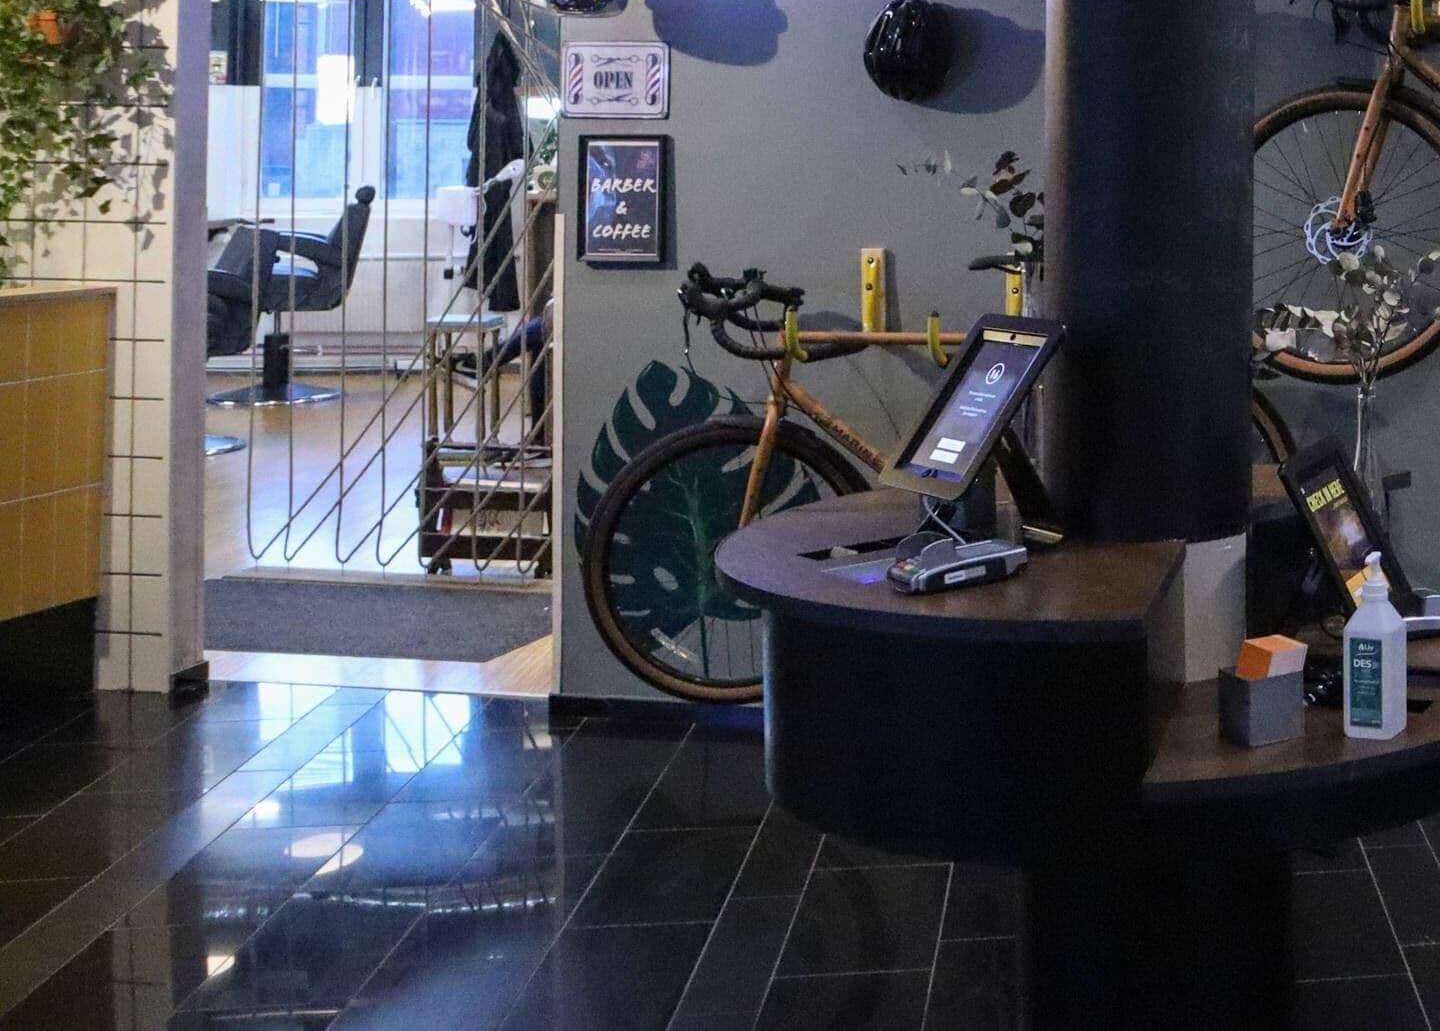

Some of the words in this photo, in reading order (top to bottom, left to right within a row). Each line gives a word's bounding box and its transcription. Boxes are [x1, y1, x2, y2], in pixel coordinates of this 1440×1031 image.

[593, 70, 633, 89] OPEN
[591, 177, 657, 193] BARBER
[615, 200, 628, 216] &
[592, 223, 652, 240] COFFEE
